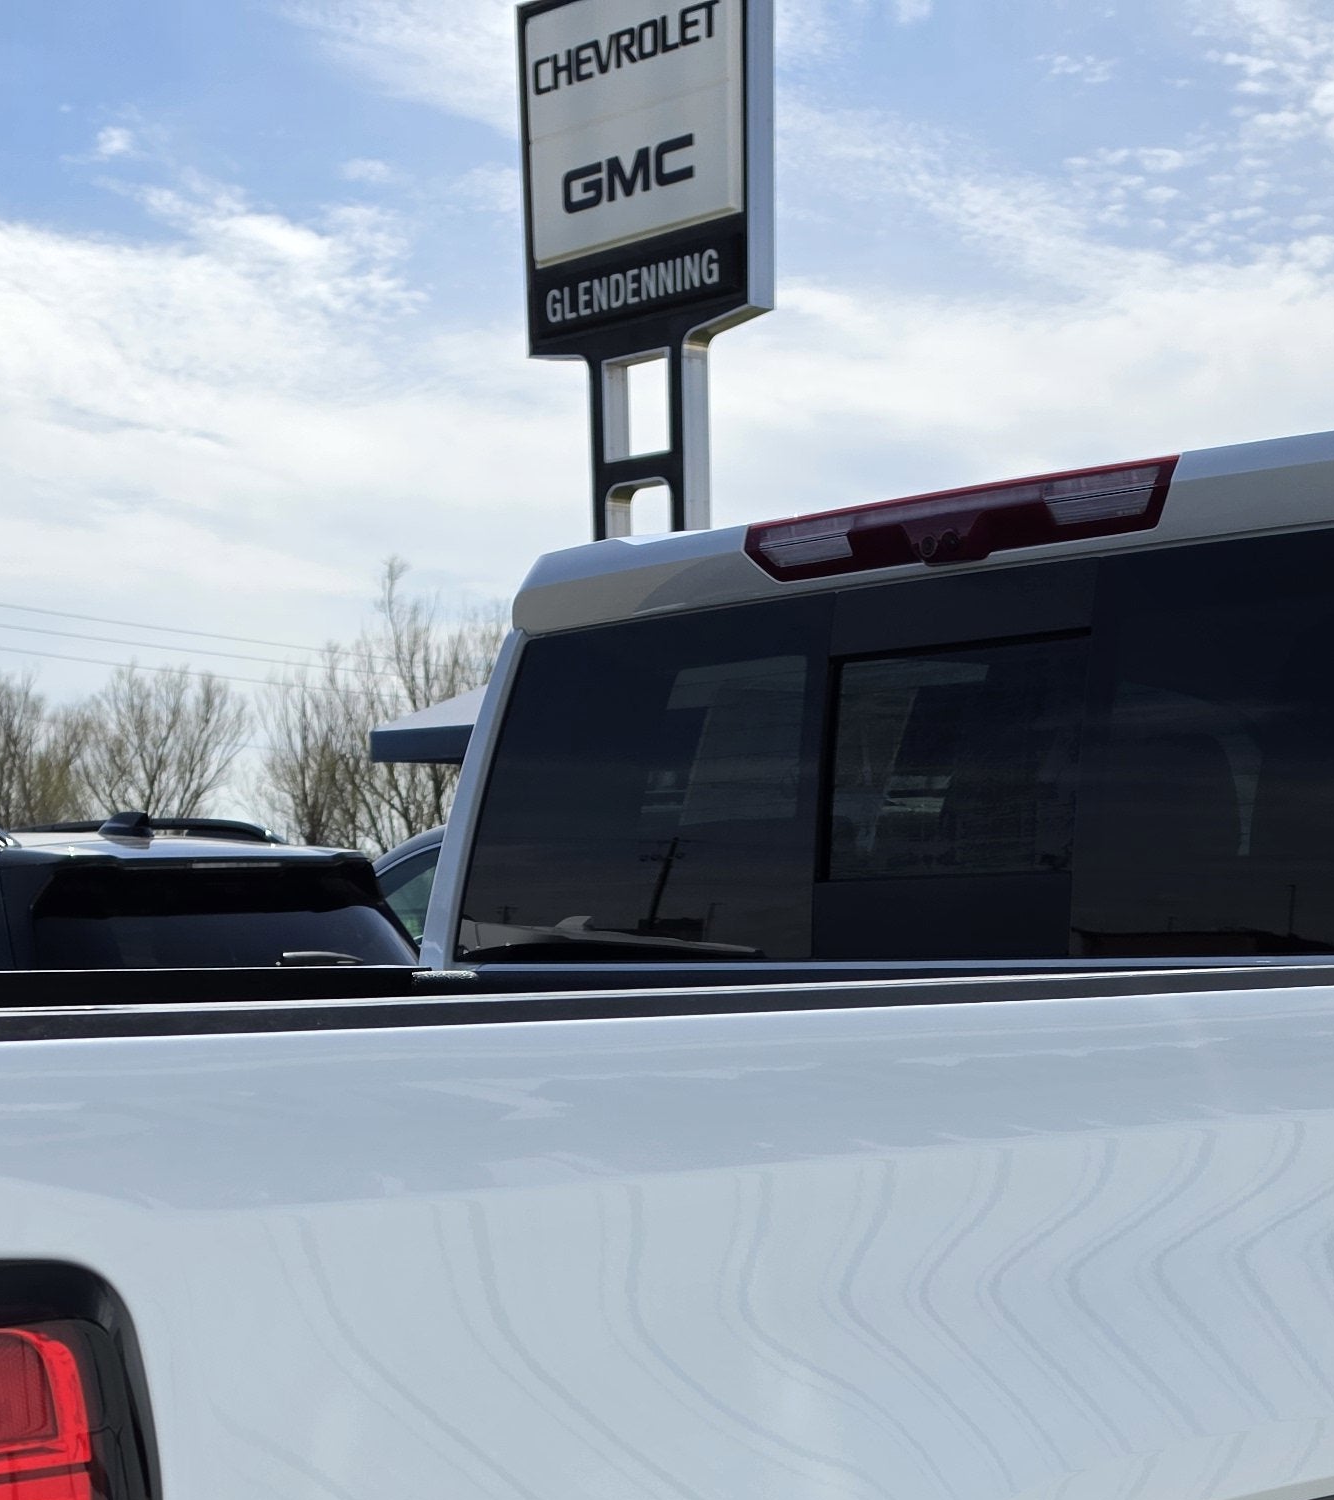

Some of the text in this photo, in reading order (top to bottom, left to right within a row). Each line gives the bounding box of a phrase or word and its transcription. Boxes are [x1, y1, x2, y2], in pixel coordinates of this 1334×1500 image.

[532, 1, 718, 96] CHEVROLET
[562, 132, 695, 215] GMC
[545, 248, 720, 324] GLENDENNING
